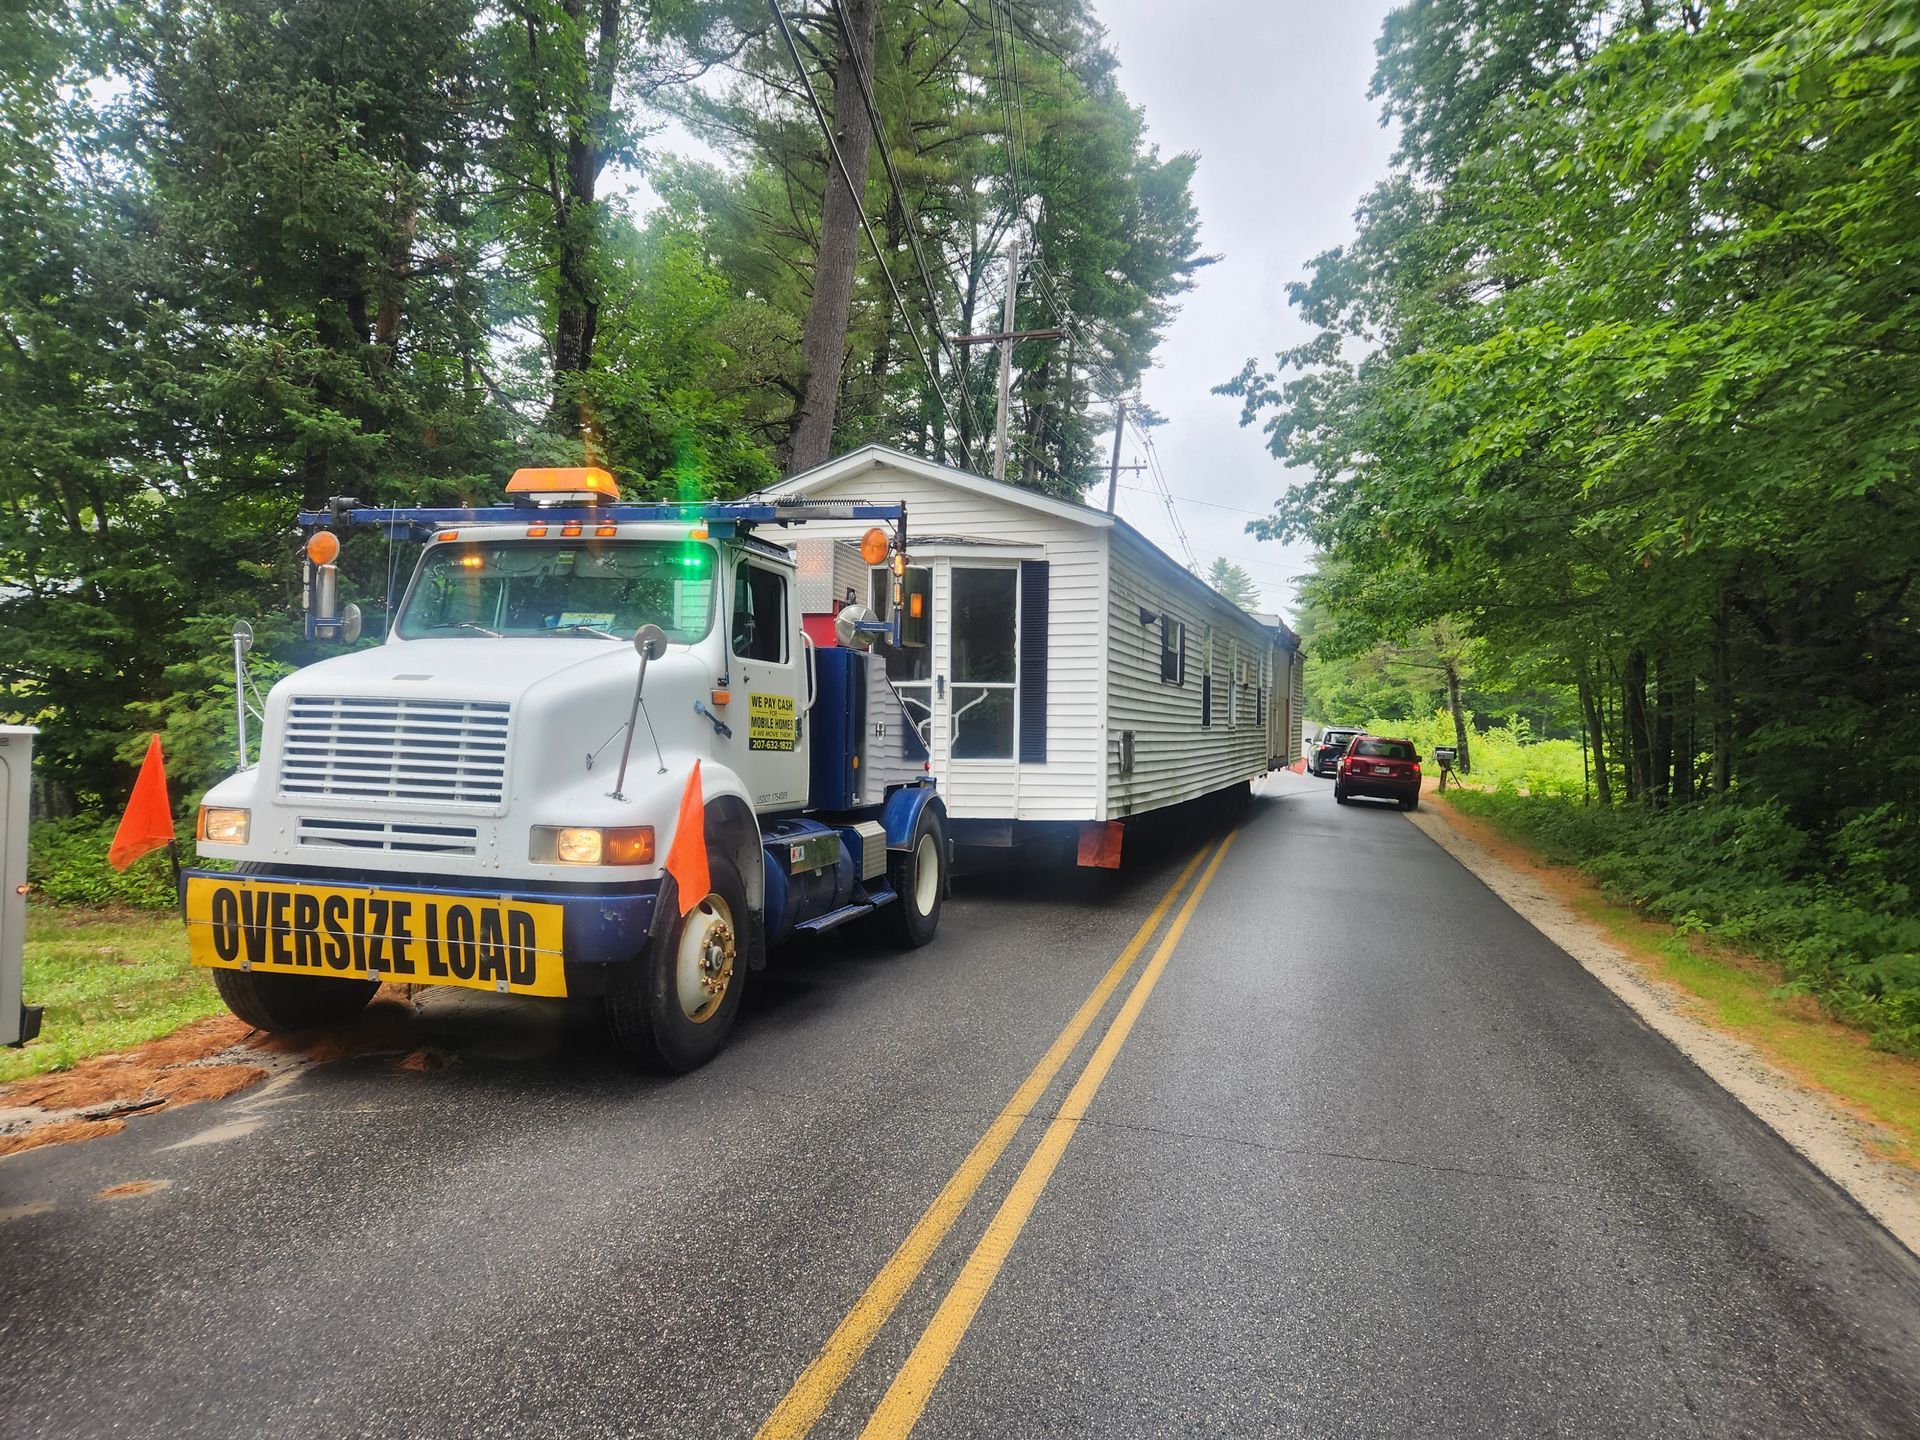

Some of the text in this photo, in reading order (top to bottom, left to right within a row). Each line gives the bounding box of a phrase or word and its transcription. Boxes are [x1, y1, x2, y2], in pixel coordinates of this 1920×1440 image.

[751, 696, 793, 711] WE PAY CASH
[751, 716, 794, 730] MOBILE HOMES
[752, 740, 793, 750] 207-632-1822
[211, 887, 537, 986] OVERSIZE LOAD
